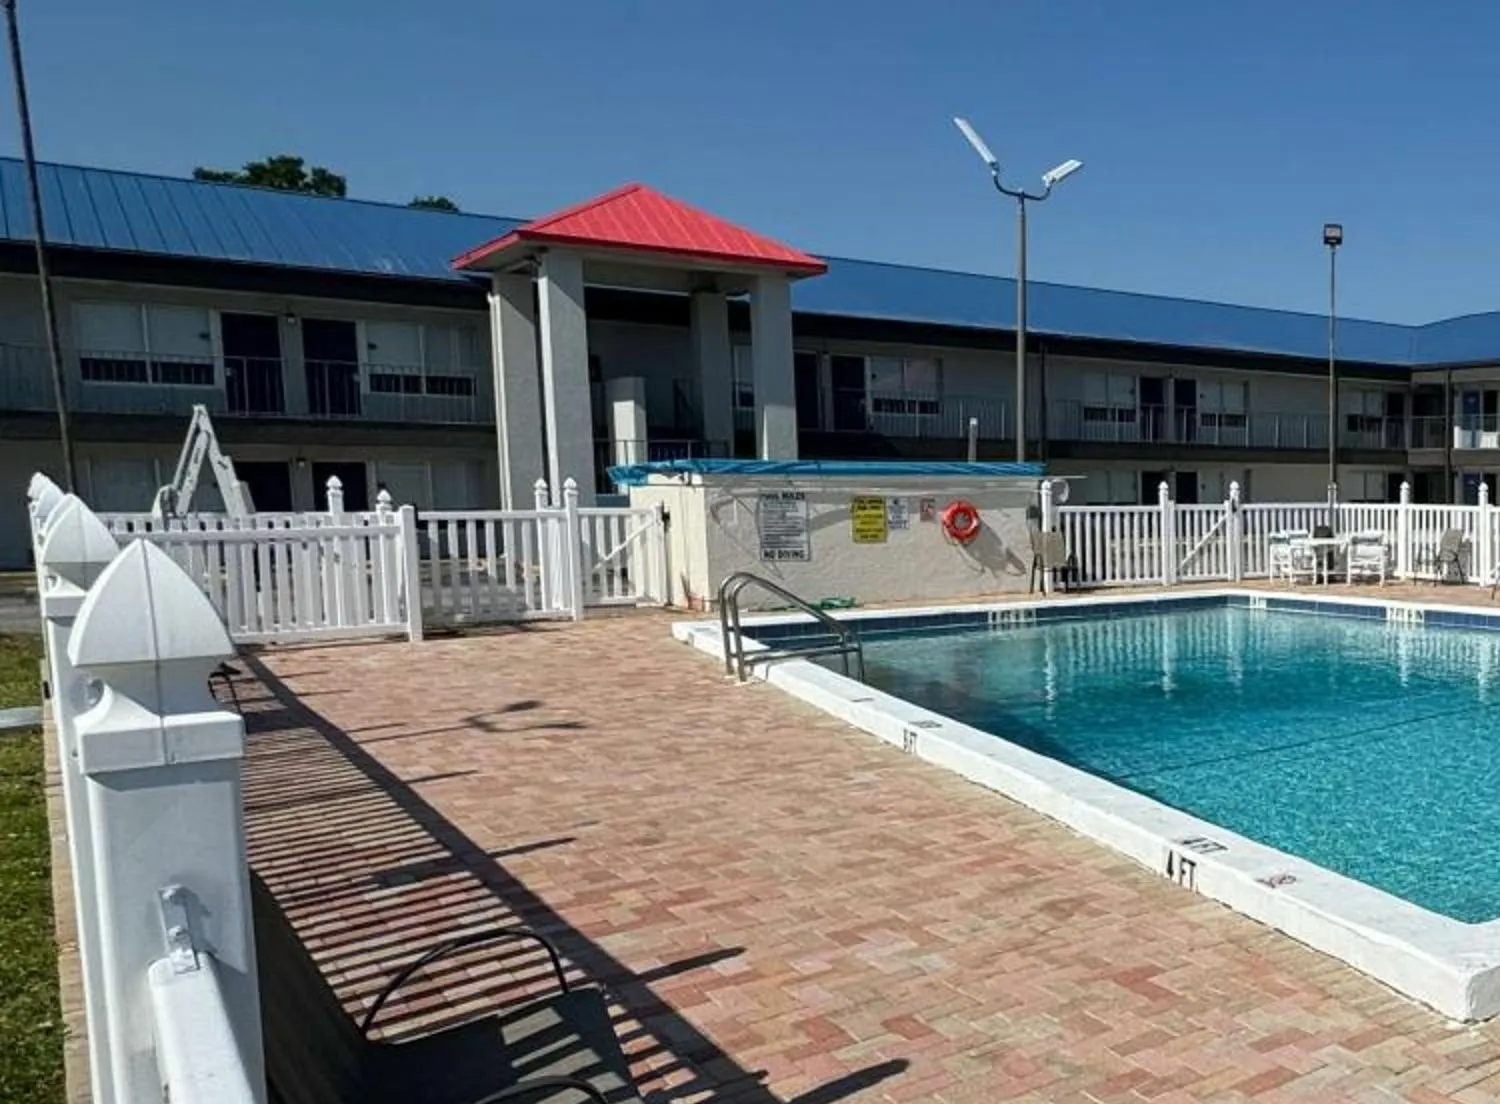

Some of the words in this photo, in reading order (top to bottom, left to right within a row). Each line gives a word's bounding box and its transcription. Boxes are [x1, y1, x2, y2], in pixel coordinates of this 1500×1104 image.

[764, 550, 774, 559] NO
[1166, 849, 1174, 880] 4
[1179, 856, 1197, 892] FT
